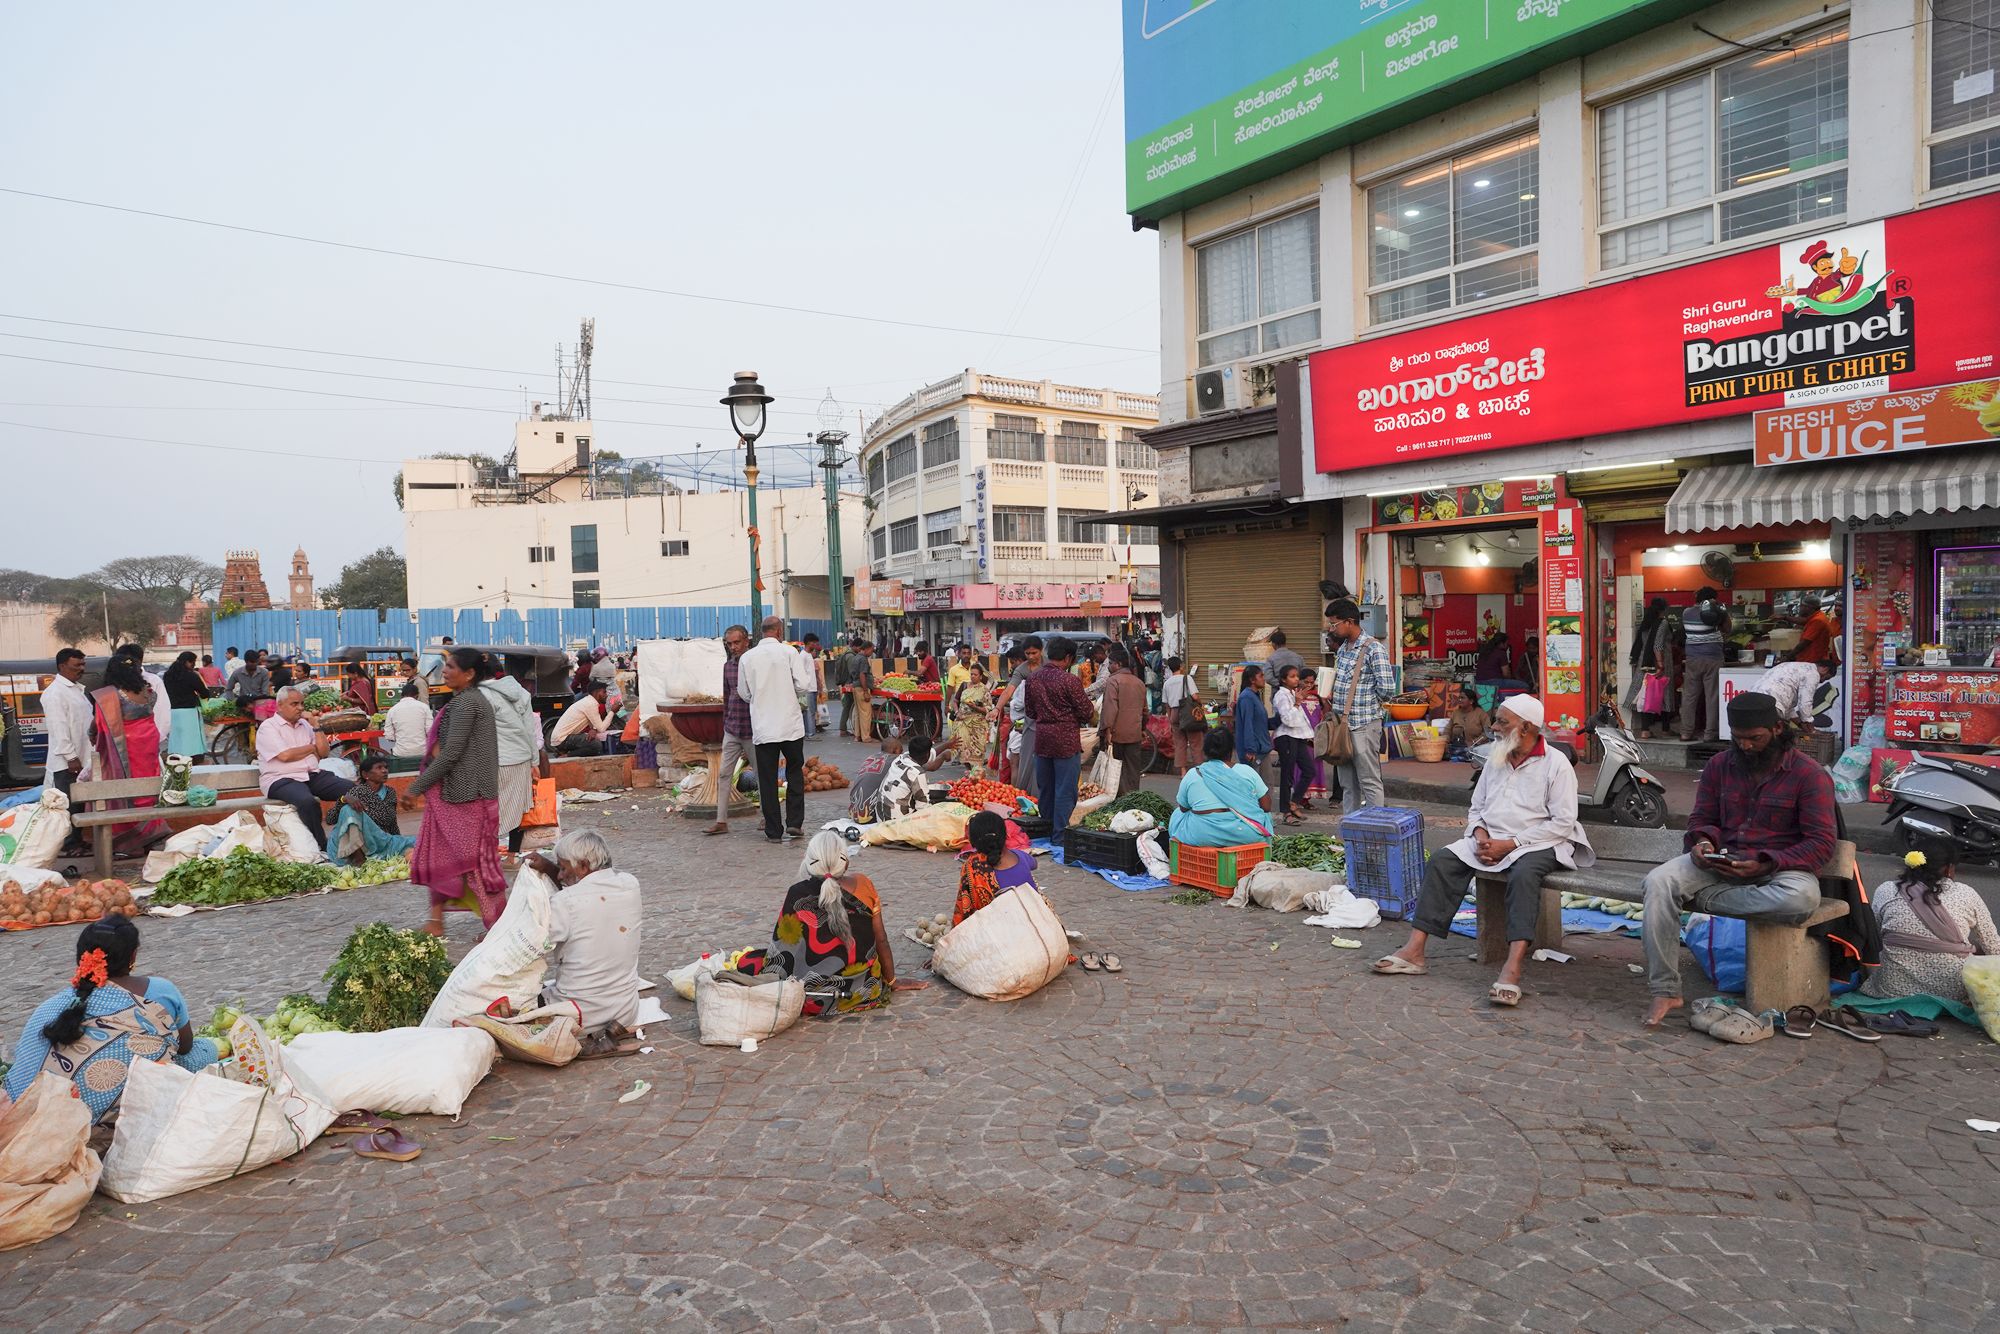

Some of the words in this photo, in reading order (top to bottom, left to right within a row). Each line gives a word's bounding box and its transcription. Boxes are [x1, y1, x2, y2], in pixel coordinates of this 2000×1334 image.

[1385, 13, 1438, 49] ಅಸ್ತಮಾ
[1233, 77, 1298, 118] ವೆರಿಕೋಸ್
[1303, 57, 1340, 87] ವೇನ್ಸ್
[1234, 92, 1324, 145] ಸೋರಿಯಾಸಿಸ್
[1145, 124, 1195, 158] ಸಂಧಿವಾತ
[1145, 147, 1198, 182] ಮಧುಮೇಹ
[1682, 305, 1710, 320] Shri
[1711, 297, 1747, 314] Guru
[1682, 307, 1773, 335] Raghavendra
[1686, 302, 1908, 374] Bangarpet
[1389, 356, 1405, 372] ಶ್ರೀ
[1407, 351, 1431, 367] ಗುರು
[1435, 338, 1490, 360] ರಾಘವೇಂದ್ರ
[1689, 381, 1737, 404] PANI
[1743, 371, 1796, 396] PURI
[1802, 365, 1820, 384] &
[1827, 351, 1907, 381] CHATS
[1797, 388, 1818, 398] SIGN
[1819, 386, 1830, 395] OF
[1831, 383, 1859, 393] GOOD
[1860, 379, 1885, 388] TASTE
[1373, 407, 1446, 434] ಪಾನಿಪುರಿ
[1455, 402, 1471, 419] &
[1478, 389, 1531, 417] ಚಾಟ್ಸ್
[1884, 389, 1940, 412] ಜ್ಯೂಸ್
[1768, 409, 1834, 432] FRESH
[1396, 444, 1408, 453] Call
[1439, 438, 1451, 447] 717
[1769, 415, 1927, 464] JUICE
[1522, 492, 1556, 501] Bangarpet
[977, 518, 987, 570] KSIC
[1545, 535, 1575, 543] Bangarpet
[935, 589, 951, 599] KSIC
[1446, 637, 1475, 645] Raghavendra
[1457, 628, 1468, 636] Guru
[1894, 689, 1952, 703] FRESH
